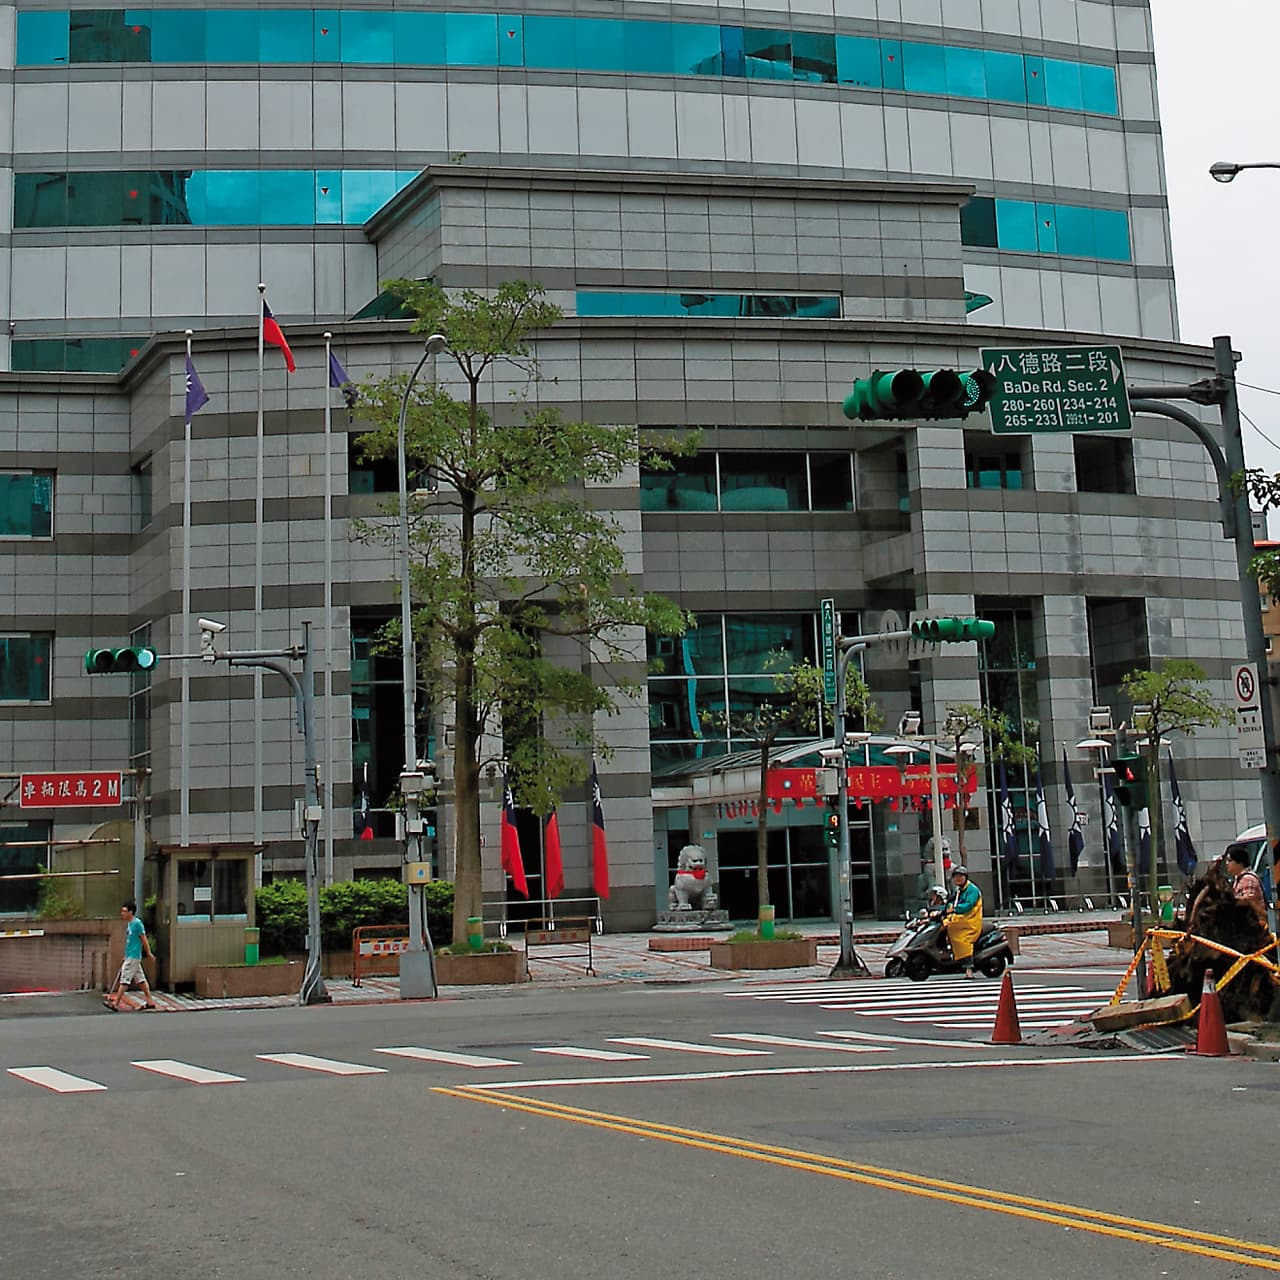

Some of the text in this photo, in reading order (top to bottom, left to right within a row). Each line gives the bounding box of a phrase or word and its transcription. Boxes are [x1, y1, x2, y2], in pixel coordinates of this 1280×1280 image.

[998, 351, 1109, 375] 八德路二段
[1003, 378, 1108, 394] BaDe Rd. Sec. 2
[1002, 396, 1117, 412] 280-260 234-214
[1004, 413, 1058, 427] 265-233
